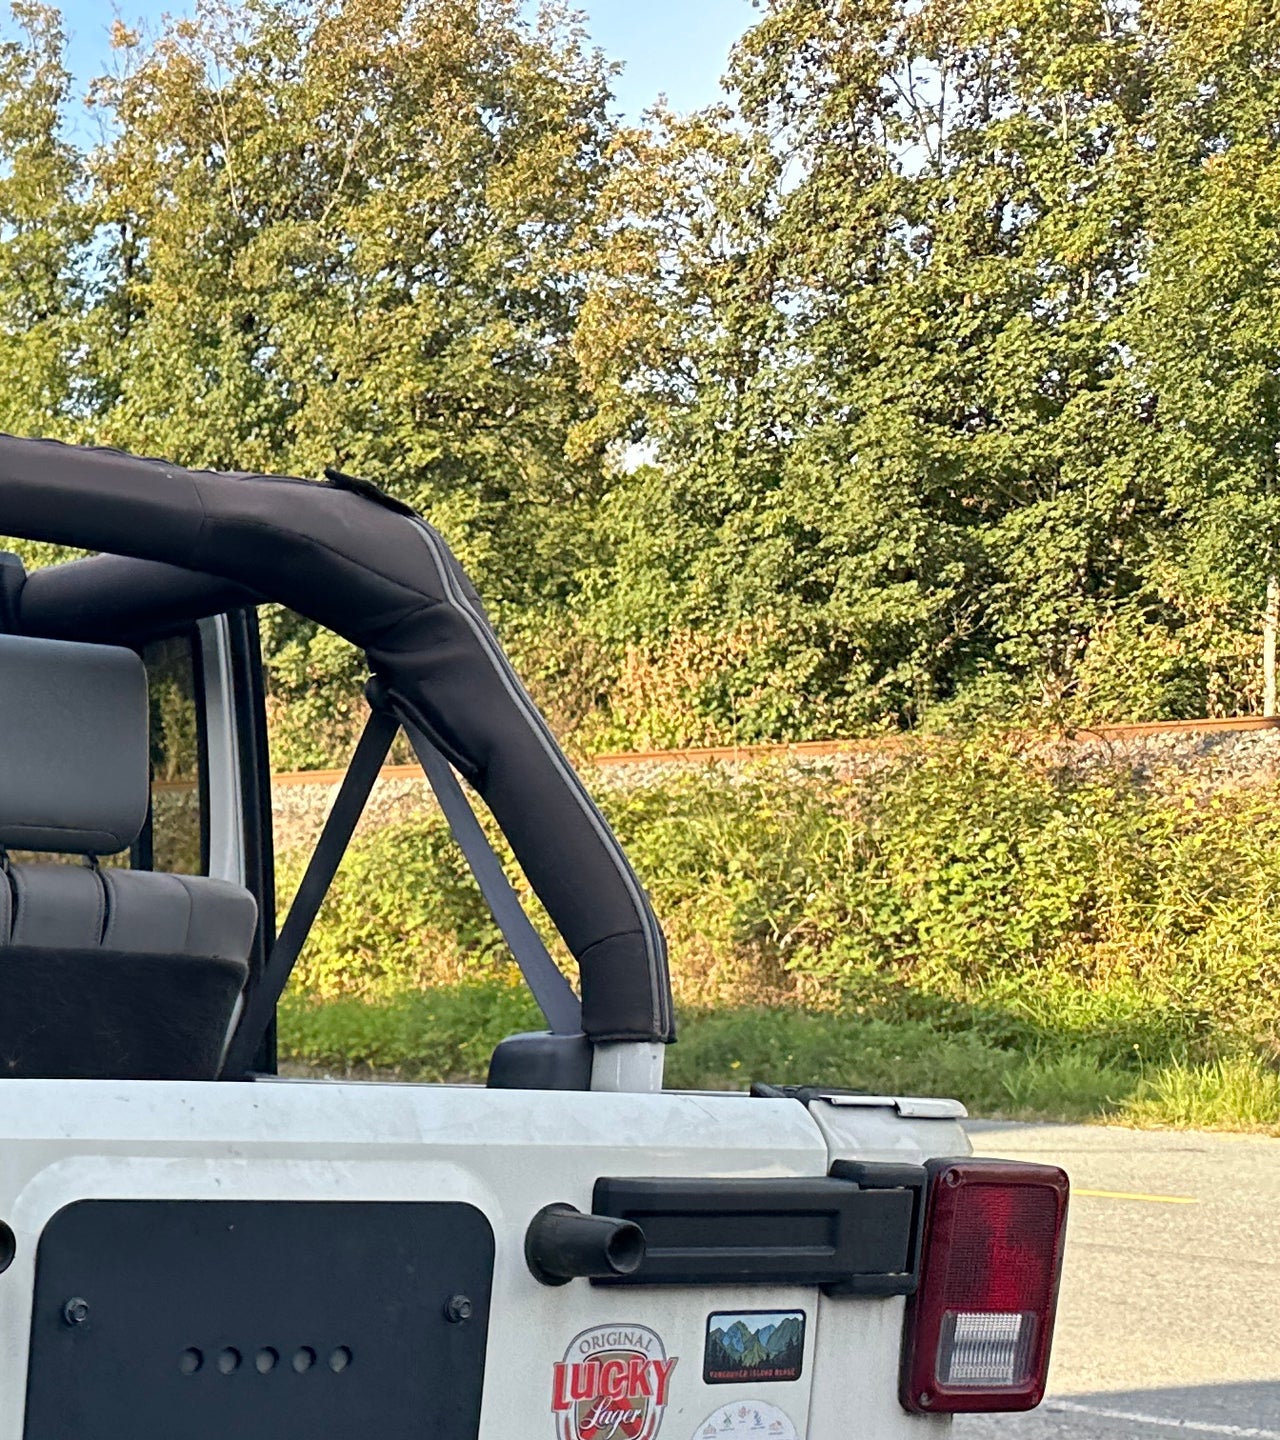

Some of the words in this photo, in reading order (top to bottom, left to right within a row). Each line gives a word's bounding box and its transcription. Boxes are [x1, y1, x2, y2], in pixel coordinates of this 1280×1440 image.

[579, 1331, 653, 1354] ORIGINAL
[551, 1357, 679, 1413] LUCKY
[579, 1395, 642, 1440] Lager
